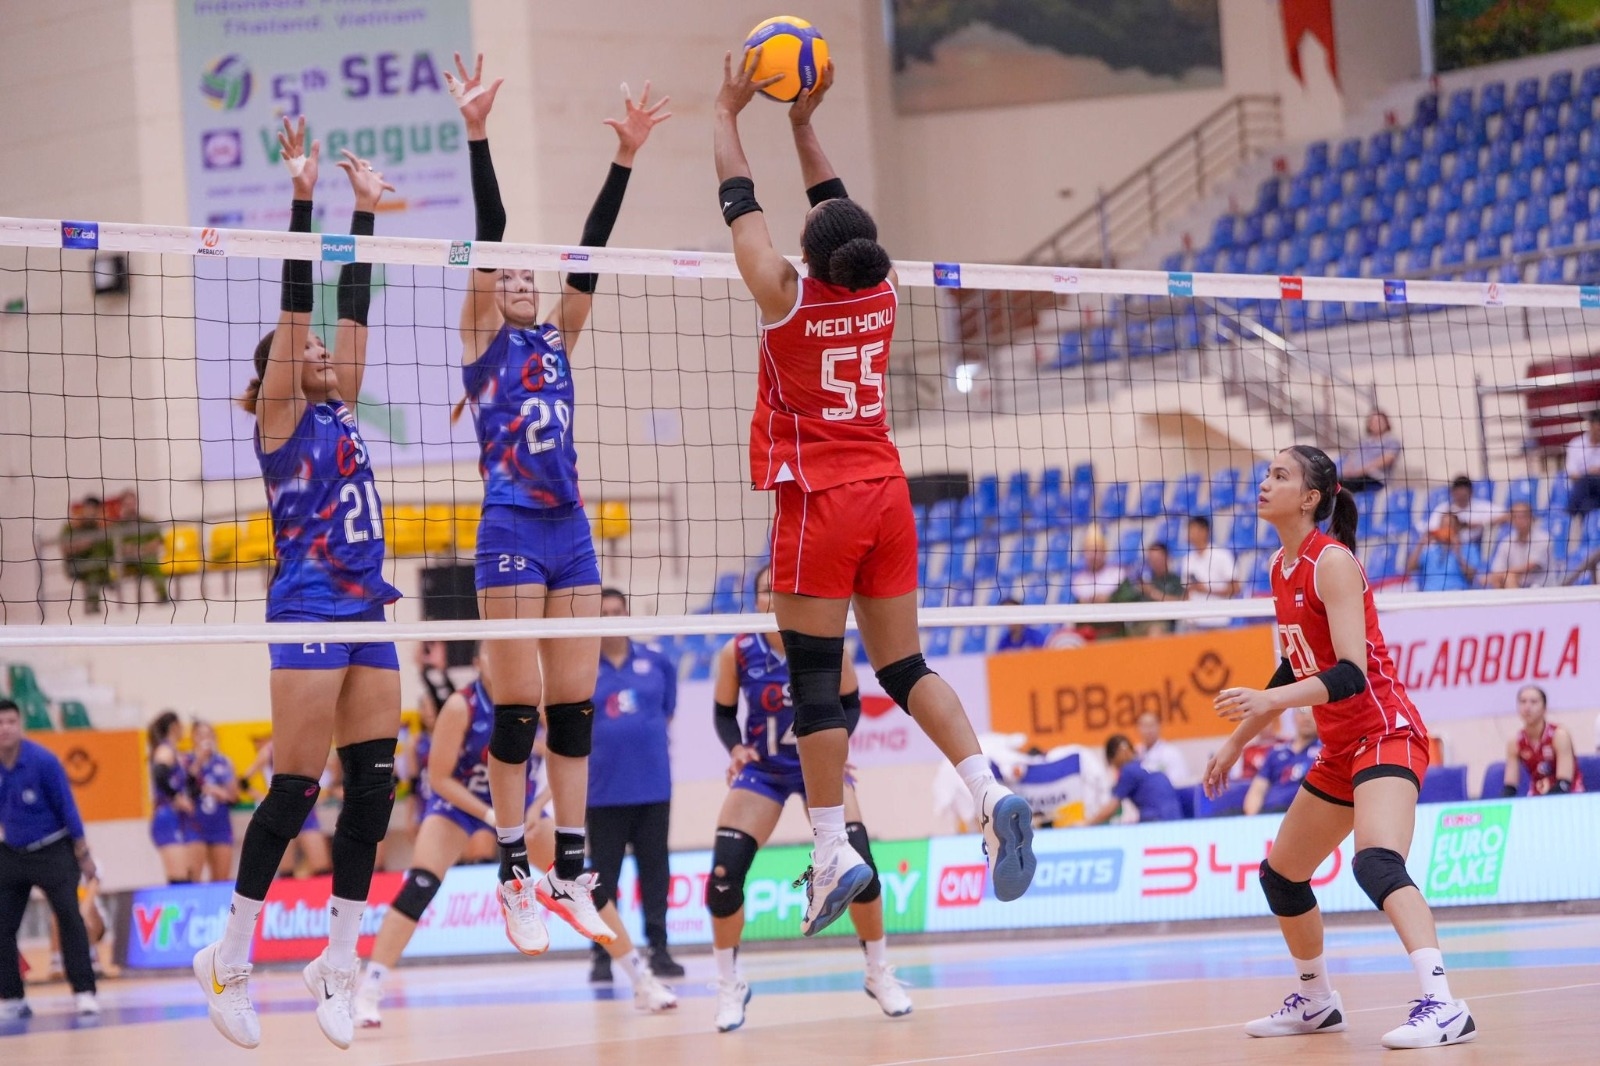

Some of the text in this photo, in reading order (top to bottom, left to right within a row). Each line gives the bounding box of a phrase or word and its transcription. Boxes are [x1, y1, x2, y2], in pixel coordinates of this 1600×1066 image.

[341, 50, 441, 98] SEA
[63, 227, 96, 240] VTVcab
[197, 248, 225, 256] MERALCO
[451, 246, 470, 255] EURO
[450, 254, 469, 264] CAKE
[804, 306, 893, 337] MEDI YOKU
[821, 340, 885, 421] 55
[520, 397, 570, 455] 29
[340, 481, 382, 543] 21
[498, 554, 527, 573] 29
[1278, 623, 1321, 678] 20
[1029, 678, 1188, 734] LPBank
[1437, 824, 1504, 864] EURO
[940, 859, 1115, 901] ON ORTS
[1431, 854, 1499, 893] CAKE
[745, 870, 920, 922] PHY
